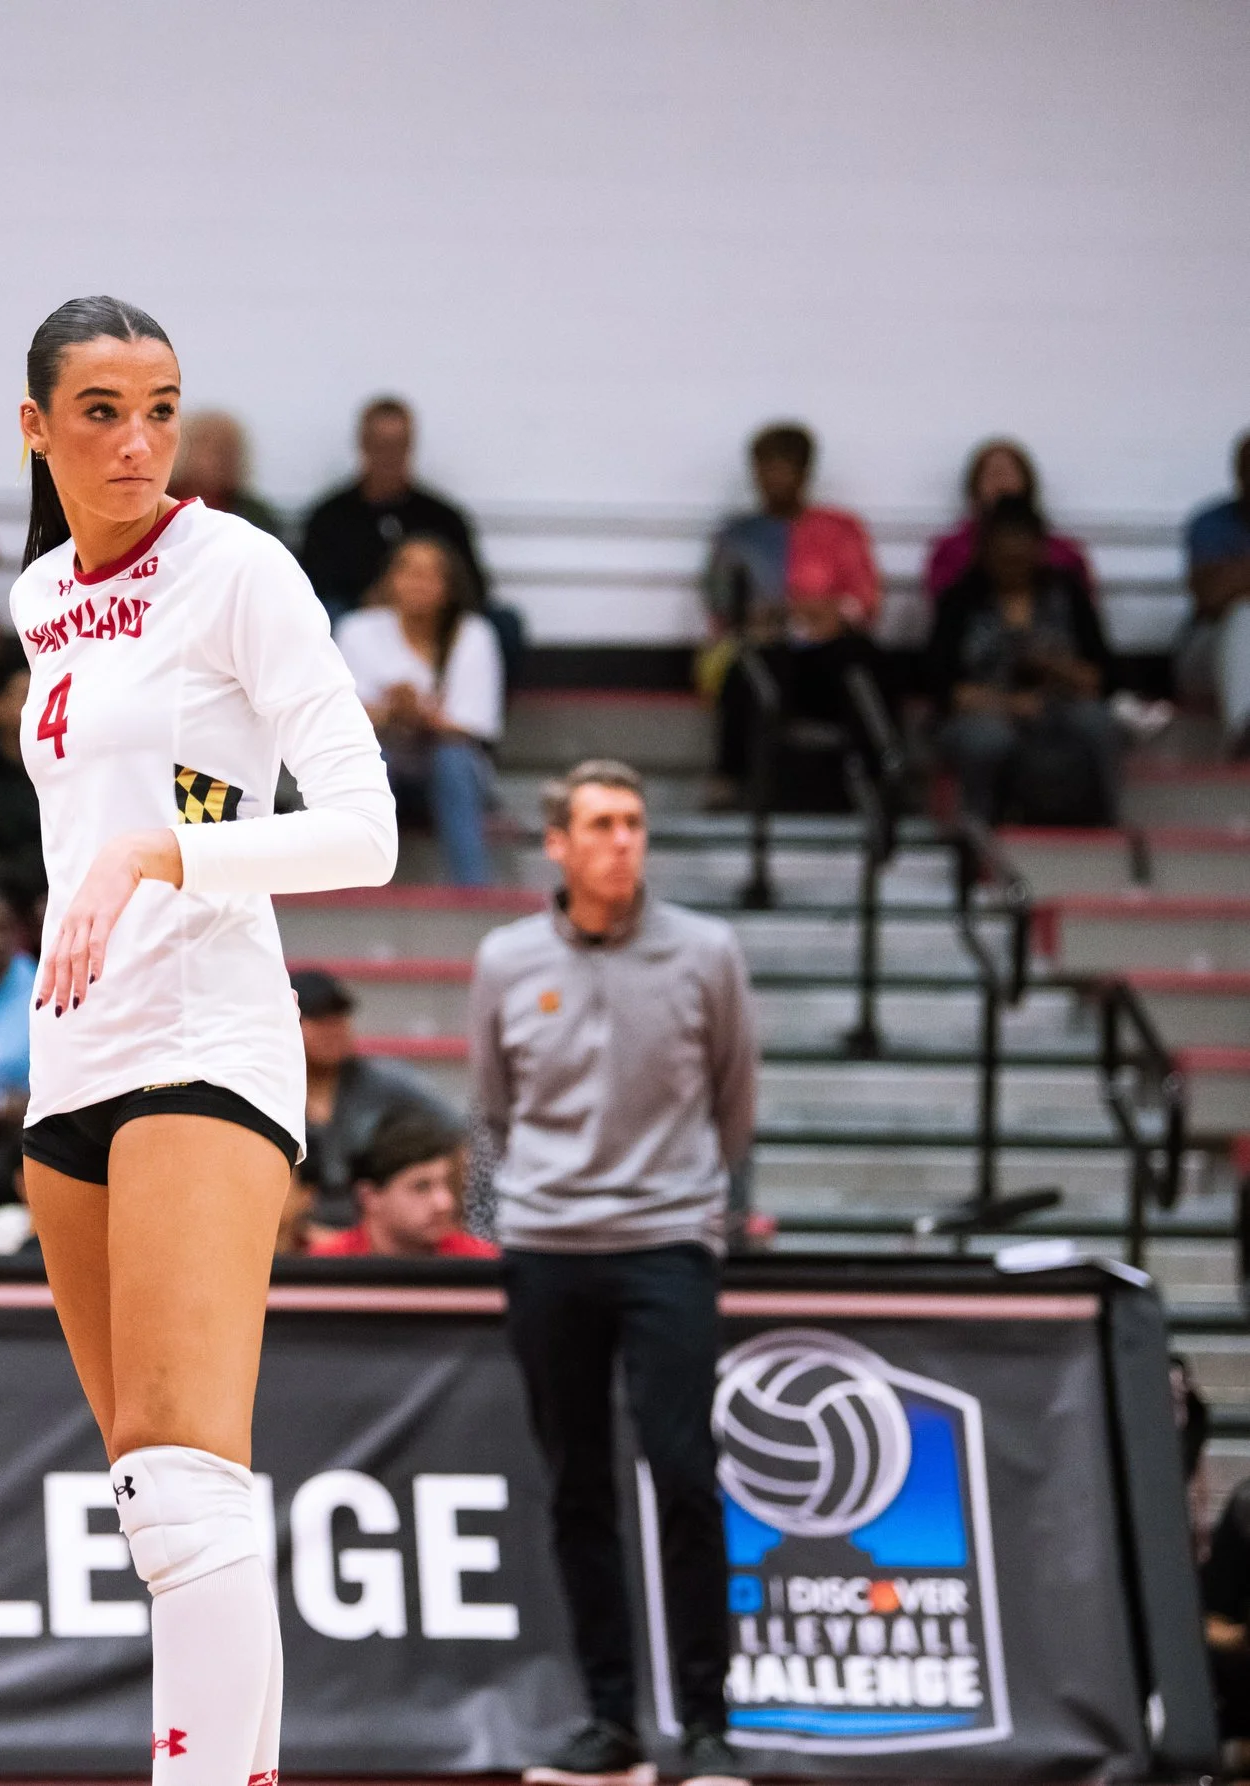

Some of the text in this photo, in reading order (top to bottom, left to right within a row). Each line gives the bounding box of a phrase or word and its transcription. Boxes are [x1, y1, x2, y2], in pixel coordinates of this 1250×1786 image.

[37, 672, 72, 760] 4
[787, 1575, 969, 1615] DISCOVER
[739, 1616, 977, 1655] LLEYBALL
